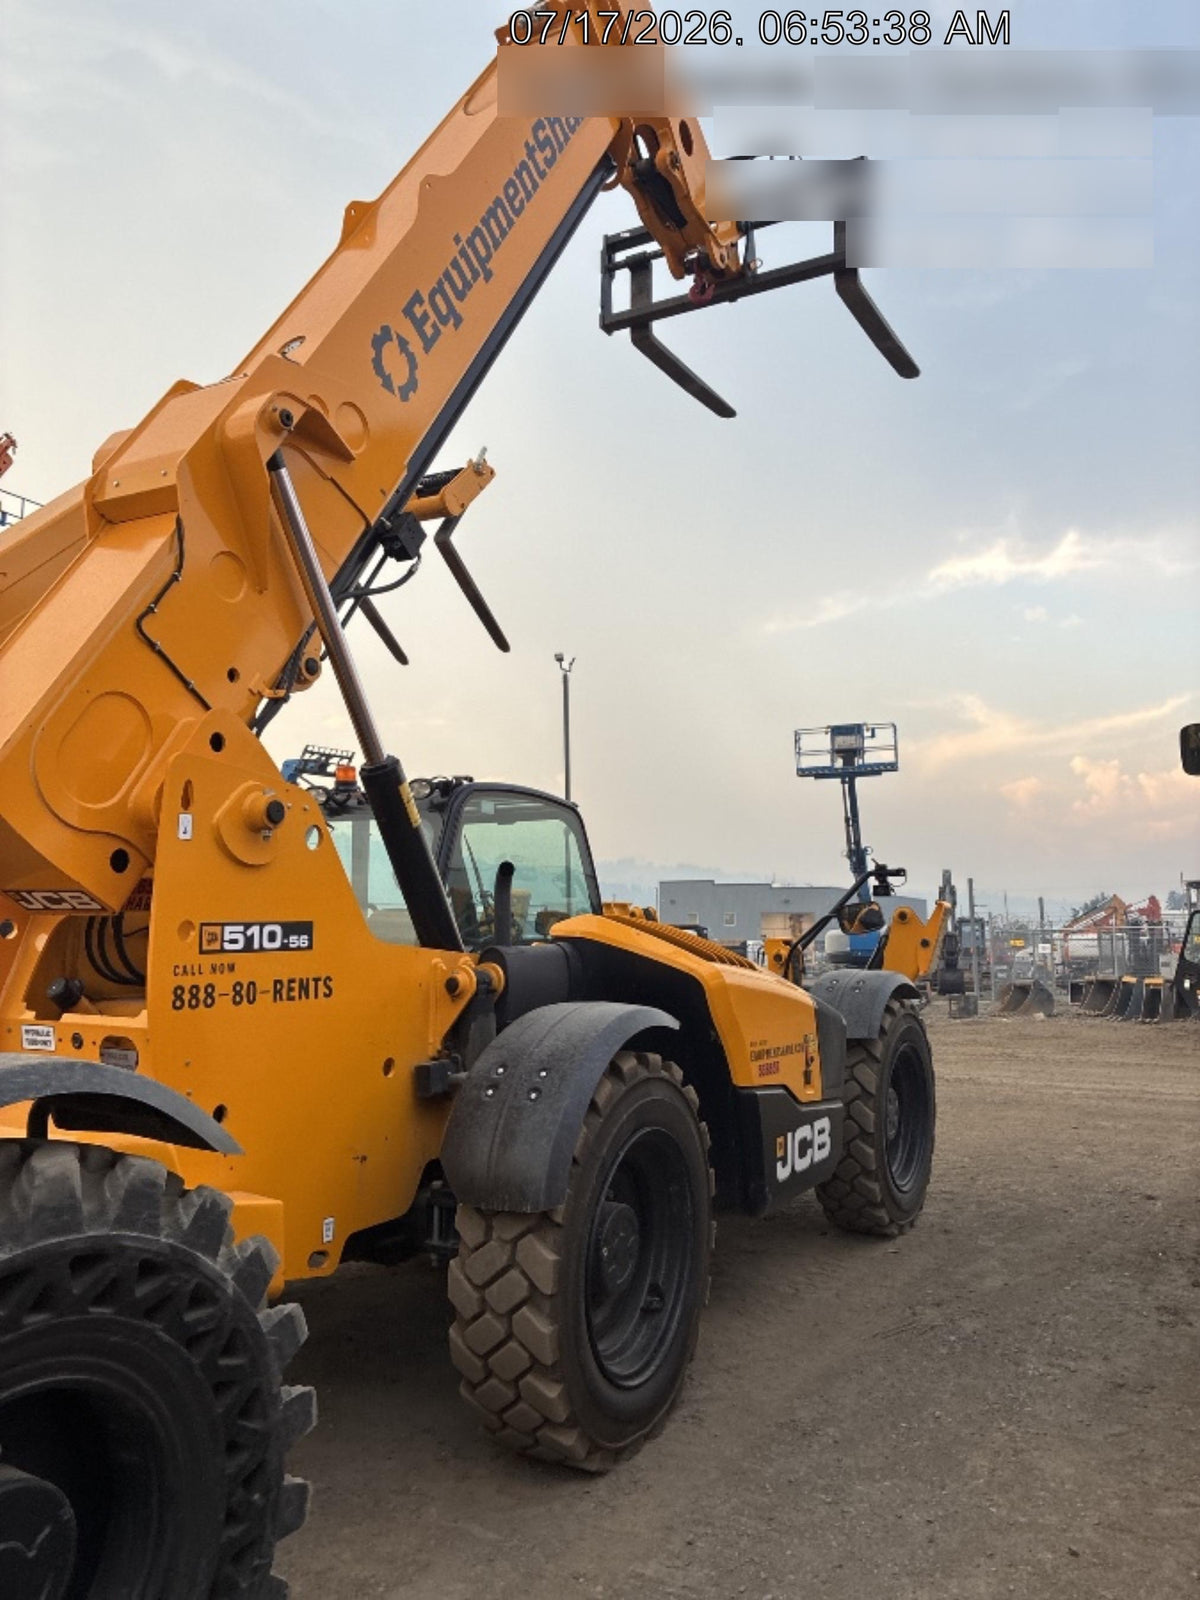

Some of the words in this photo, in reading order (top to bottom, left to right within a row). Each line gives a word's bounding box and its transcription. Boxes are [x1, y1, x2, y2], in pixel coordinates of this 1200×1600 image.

[18, 891, 102, 910] JCB
[173, 964, 204, 977] CALL
[210, 962, 236, 975] NOW
[172, 976, 334, 1011] 888-80-RENTS
[776, 1116, 831, 1183] JCB
